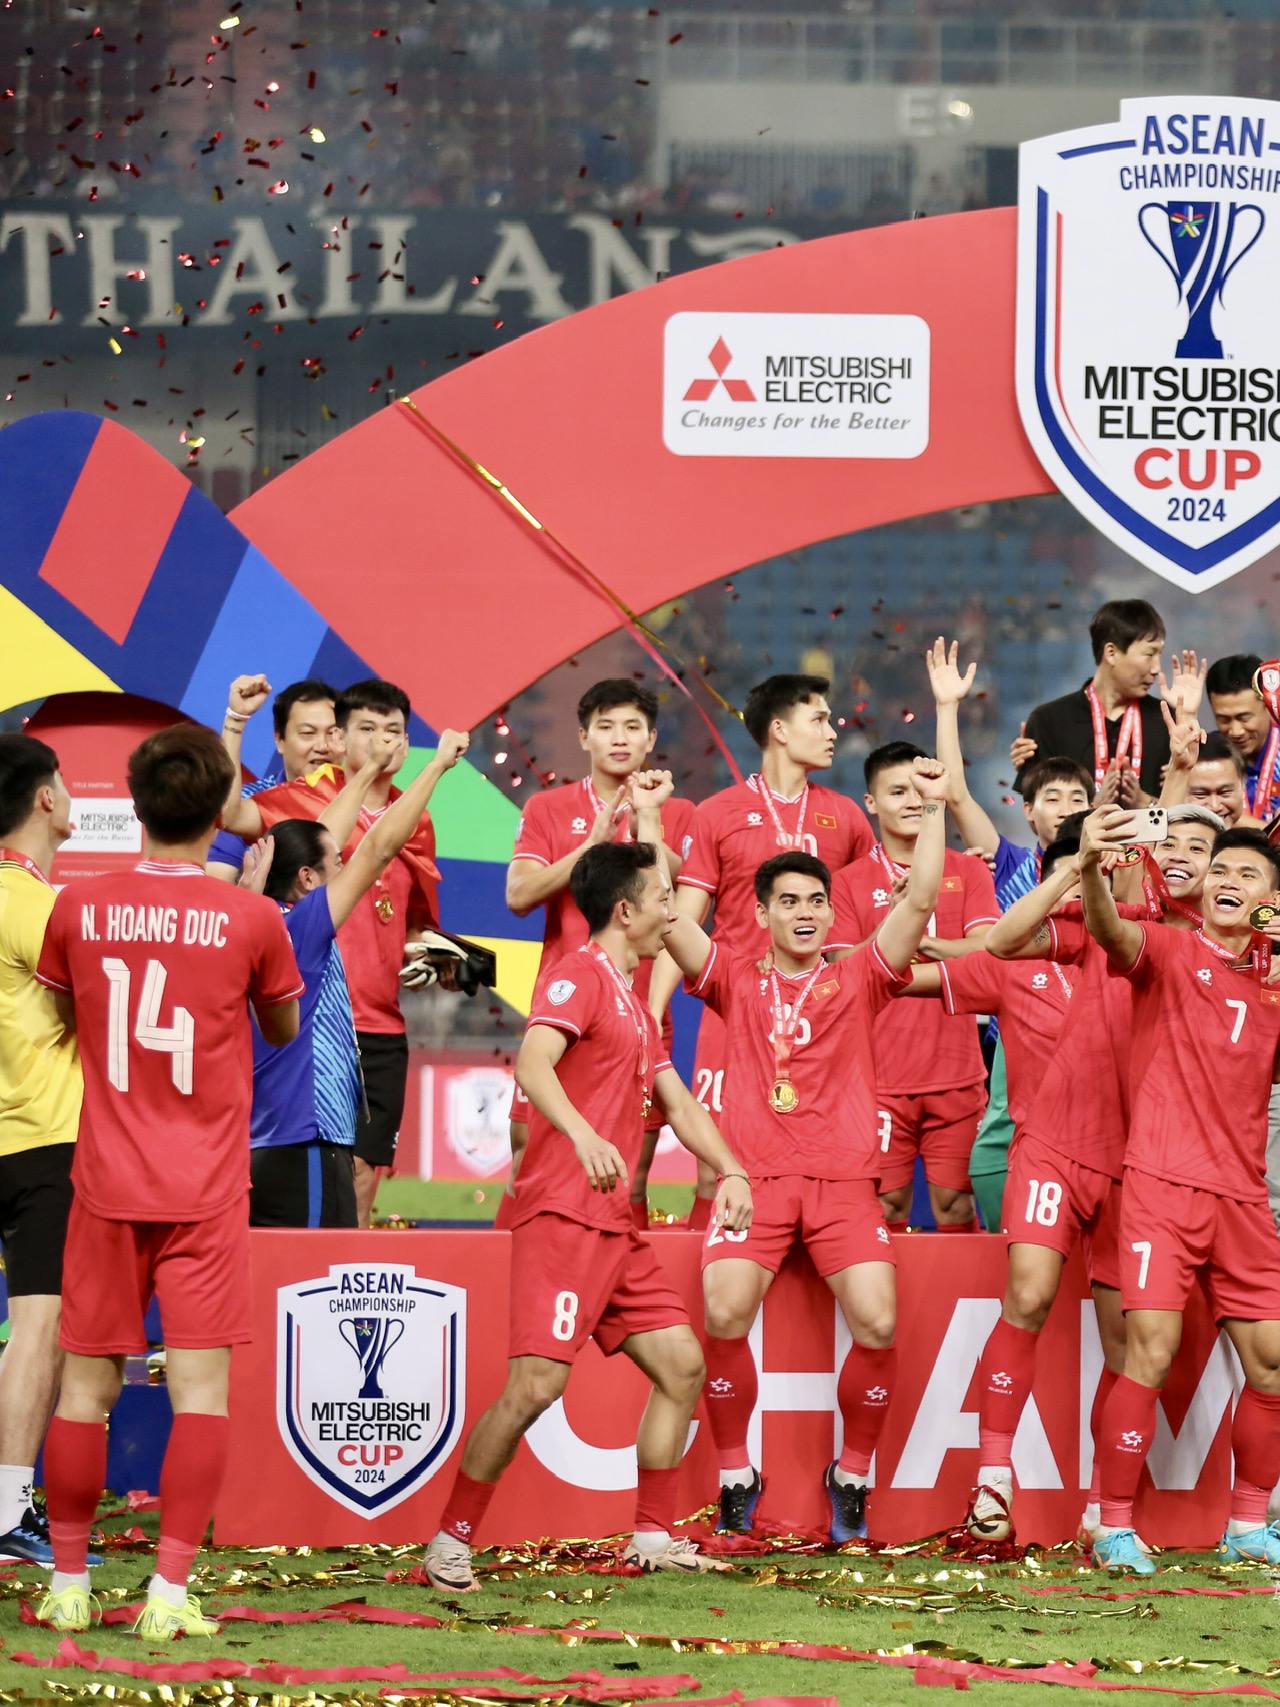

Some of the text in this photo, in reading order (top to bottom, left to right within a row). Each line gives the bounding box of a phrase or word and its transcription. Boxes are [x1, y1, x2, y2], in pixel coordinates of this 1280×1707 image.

[1142, 114, 1266, 158] ASEAN
[0, 213, 804, 327] THAILAN
[765, 355, 912, 379] MITSUBISHI
[765, 381, 892, 404] ELECTRIC
[681, 409, 911, 431] Changes for the Better
[1134, 446, 1262, 491] CUP
[1167, 497, 1227, 522] 2024
[80, 813, 135, 822] MITSUBISHI
[80, 823, 128, 831] ELECTRIC
[81, 904, 229, 948] N. HOANG DUC
[103, 957, 195, 1095] 14
[1225, 998, 1248, 1044] 7
[1025, 1179, 1063, 1227] 18
[1132, 1241, 1152, 1290] 7
[340, 1272, 405, 1295] ASEAN
[329, 1297, 416, 1313] CHAMPIONSHIP
[552, 1290, 579, 1341] 8
[311, 1402, 430, 1421] MITSUBISHI
[319, 1423, 422, 1441] ELECTRIC
[337, 1444, 404, 1466] CUP
[354, 1469, 386, 1483] 2024
